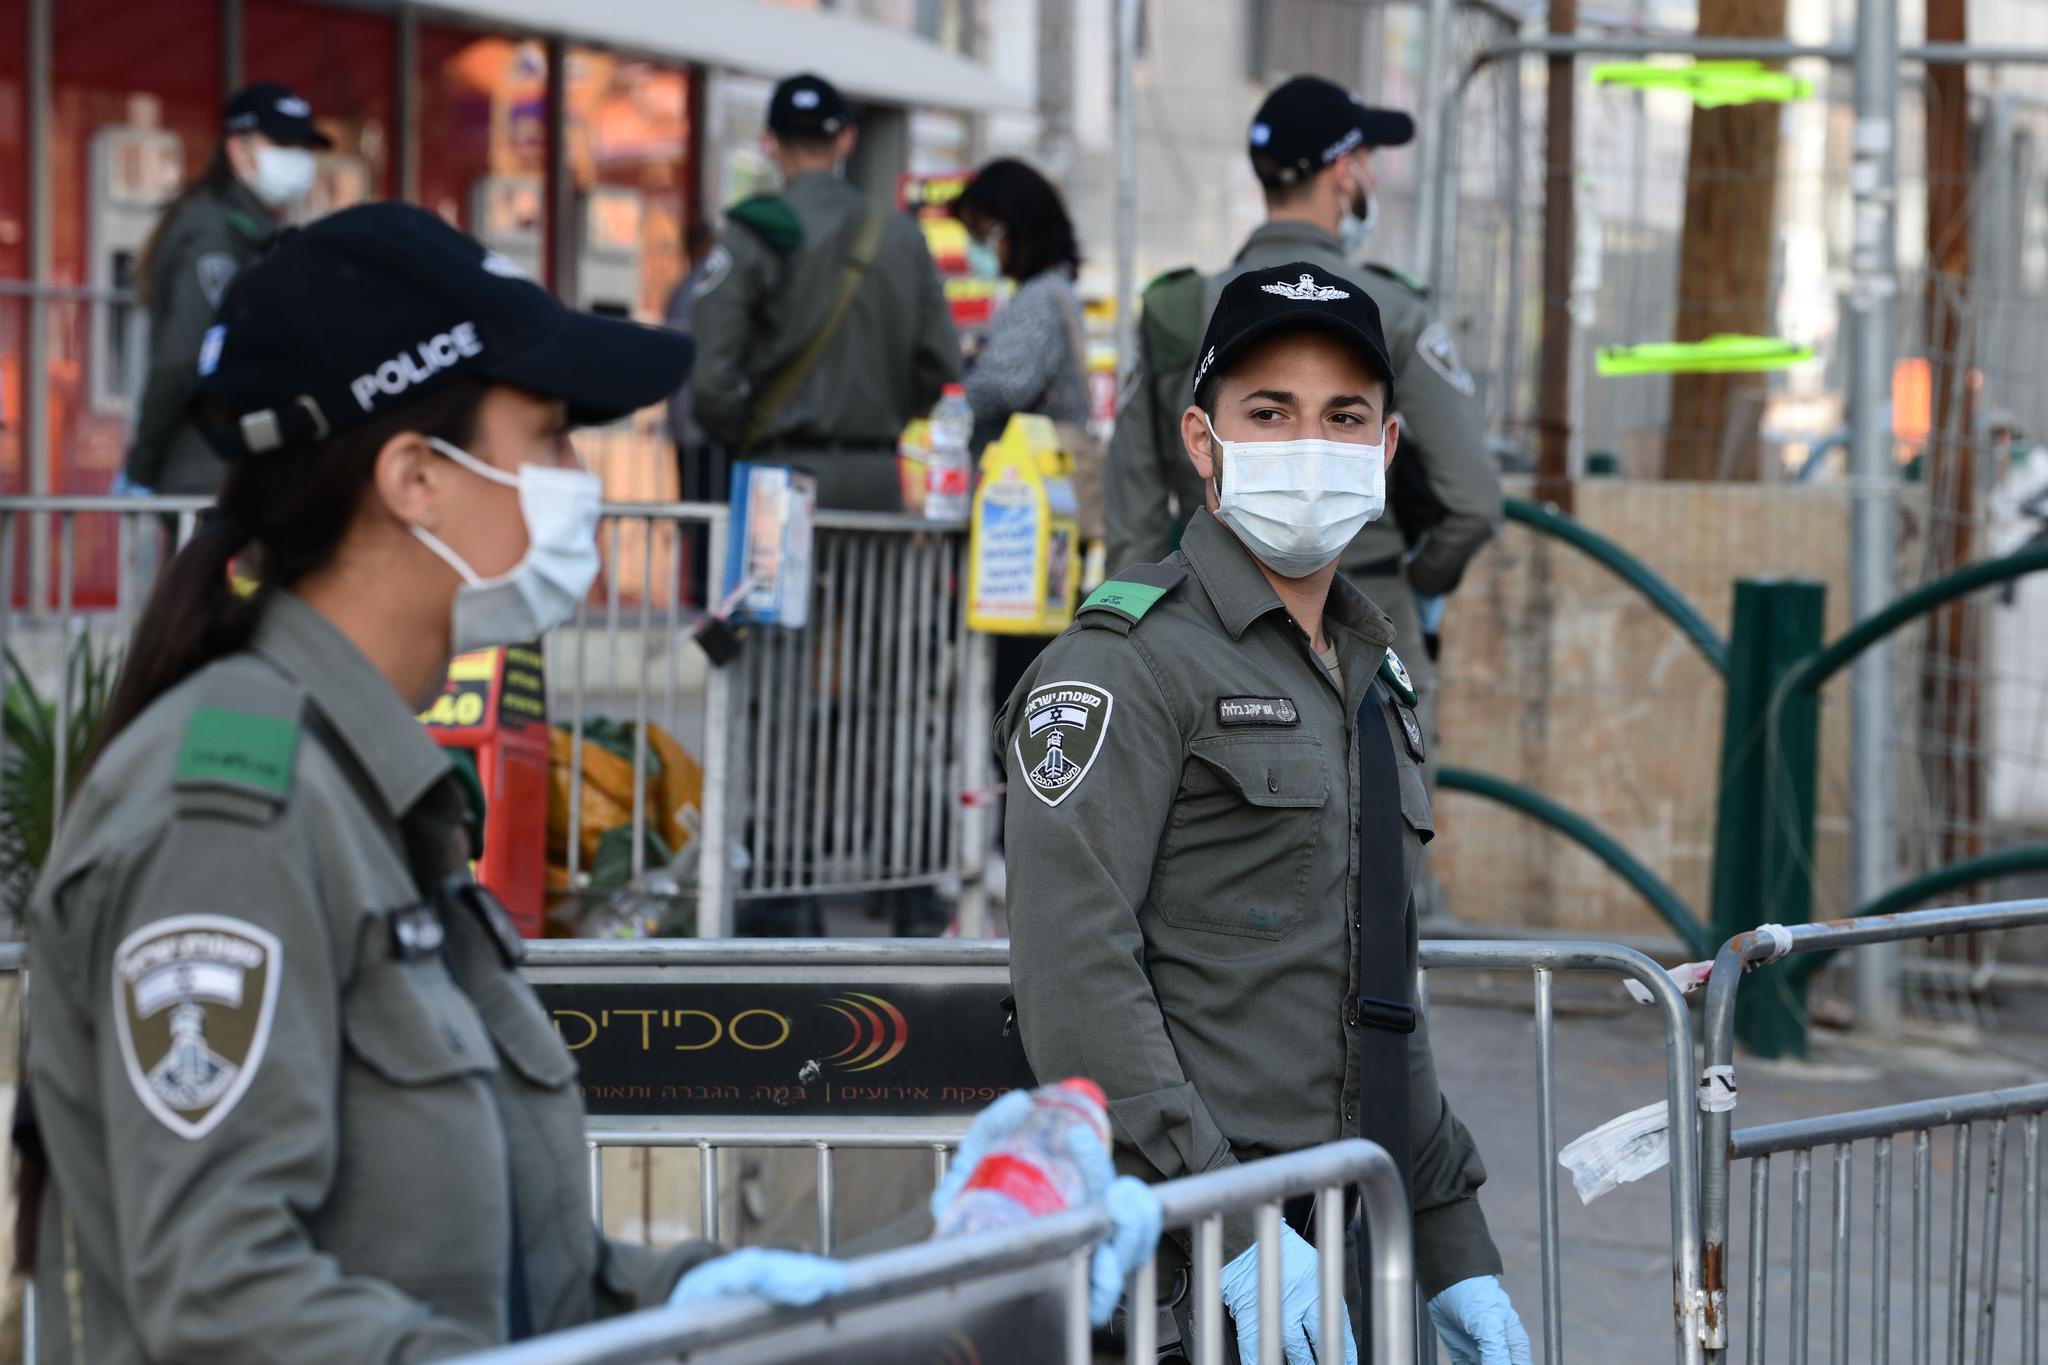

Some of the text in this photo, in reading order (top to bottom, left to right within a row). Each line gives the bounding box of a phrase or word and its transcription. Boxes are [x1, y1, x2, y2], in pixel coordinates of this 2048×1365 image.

[350, 320, 484, 412] POLICE
[1056, 691, 1102, 708] משטרת
[544, 1009, 791, 1051] ספידיק
[661, 1086, 740, 1099] הגברה
[840, 1086, 929, 1100] אירועים
